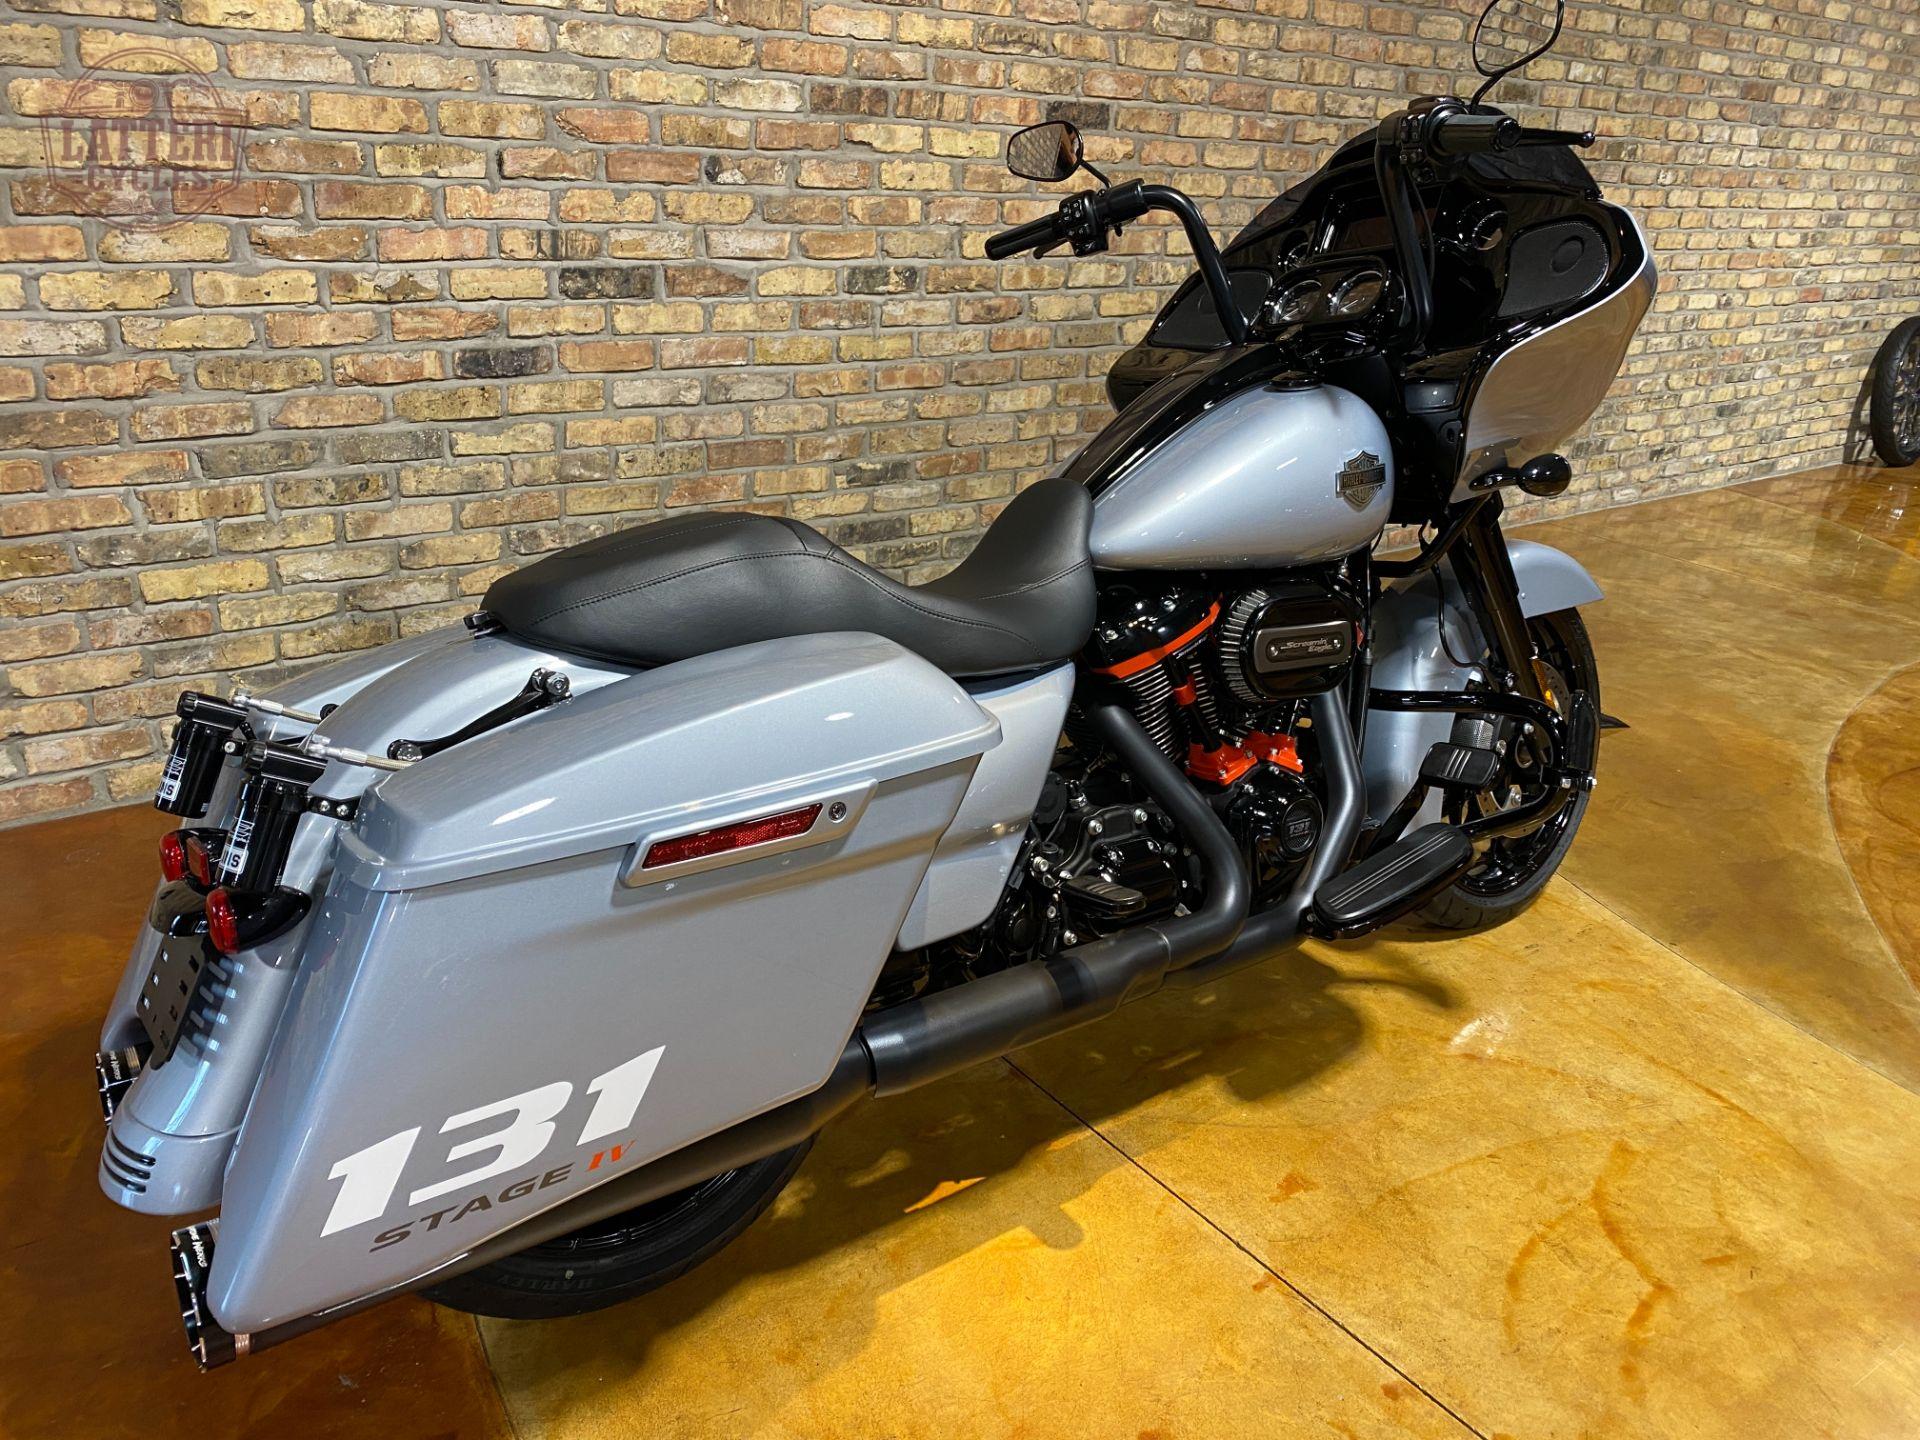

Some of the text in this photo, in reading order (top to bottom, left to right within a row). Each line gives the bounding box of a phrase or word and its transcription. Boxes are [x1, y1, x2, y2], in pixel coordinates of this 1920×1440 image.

[320, 1045, 667, 1238] 131
[369, 1140, 637, 1253] STAGE IV
